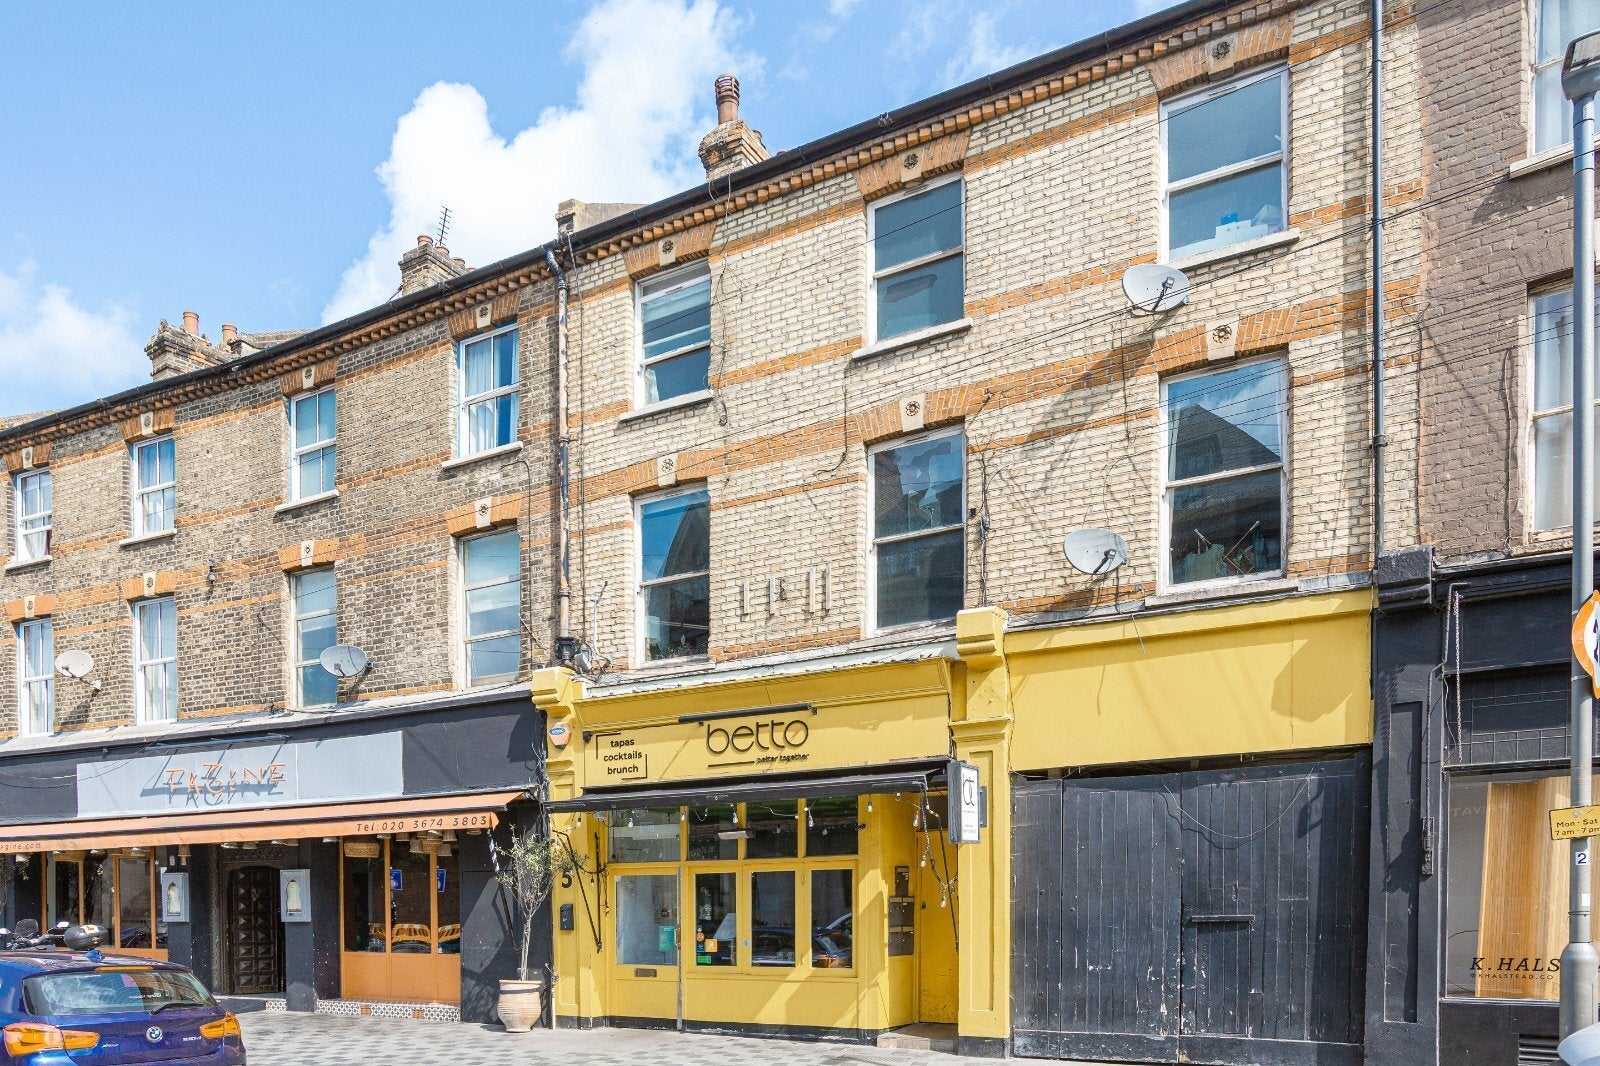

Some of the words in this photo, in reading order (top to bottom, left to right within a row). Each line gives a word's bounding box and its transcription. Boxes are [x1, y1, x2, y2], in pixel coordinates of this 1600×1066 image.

[706, 720, 809, 754] betto
[610, 739, 635, 748] tapas
[603, 751, 643, 761] cocktails
[607, 764, 639, 775] brunch
[413, 818, 443, 829] 3674
[453, 815, 487, 826] 3803
[1582, 818, 1598, 826] Sat
[1577, 852, 1587, 865] 2
